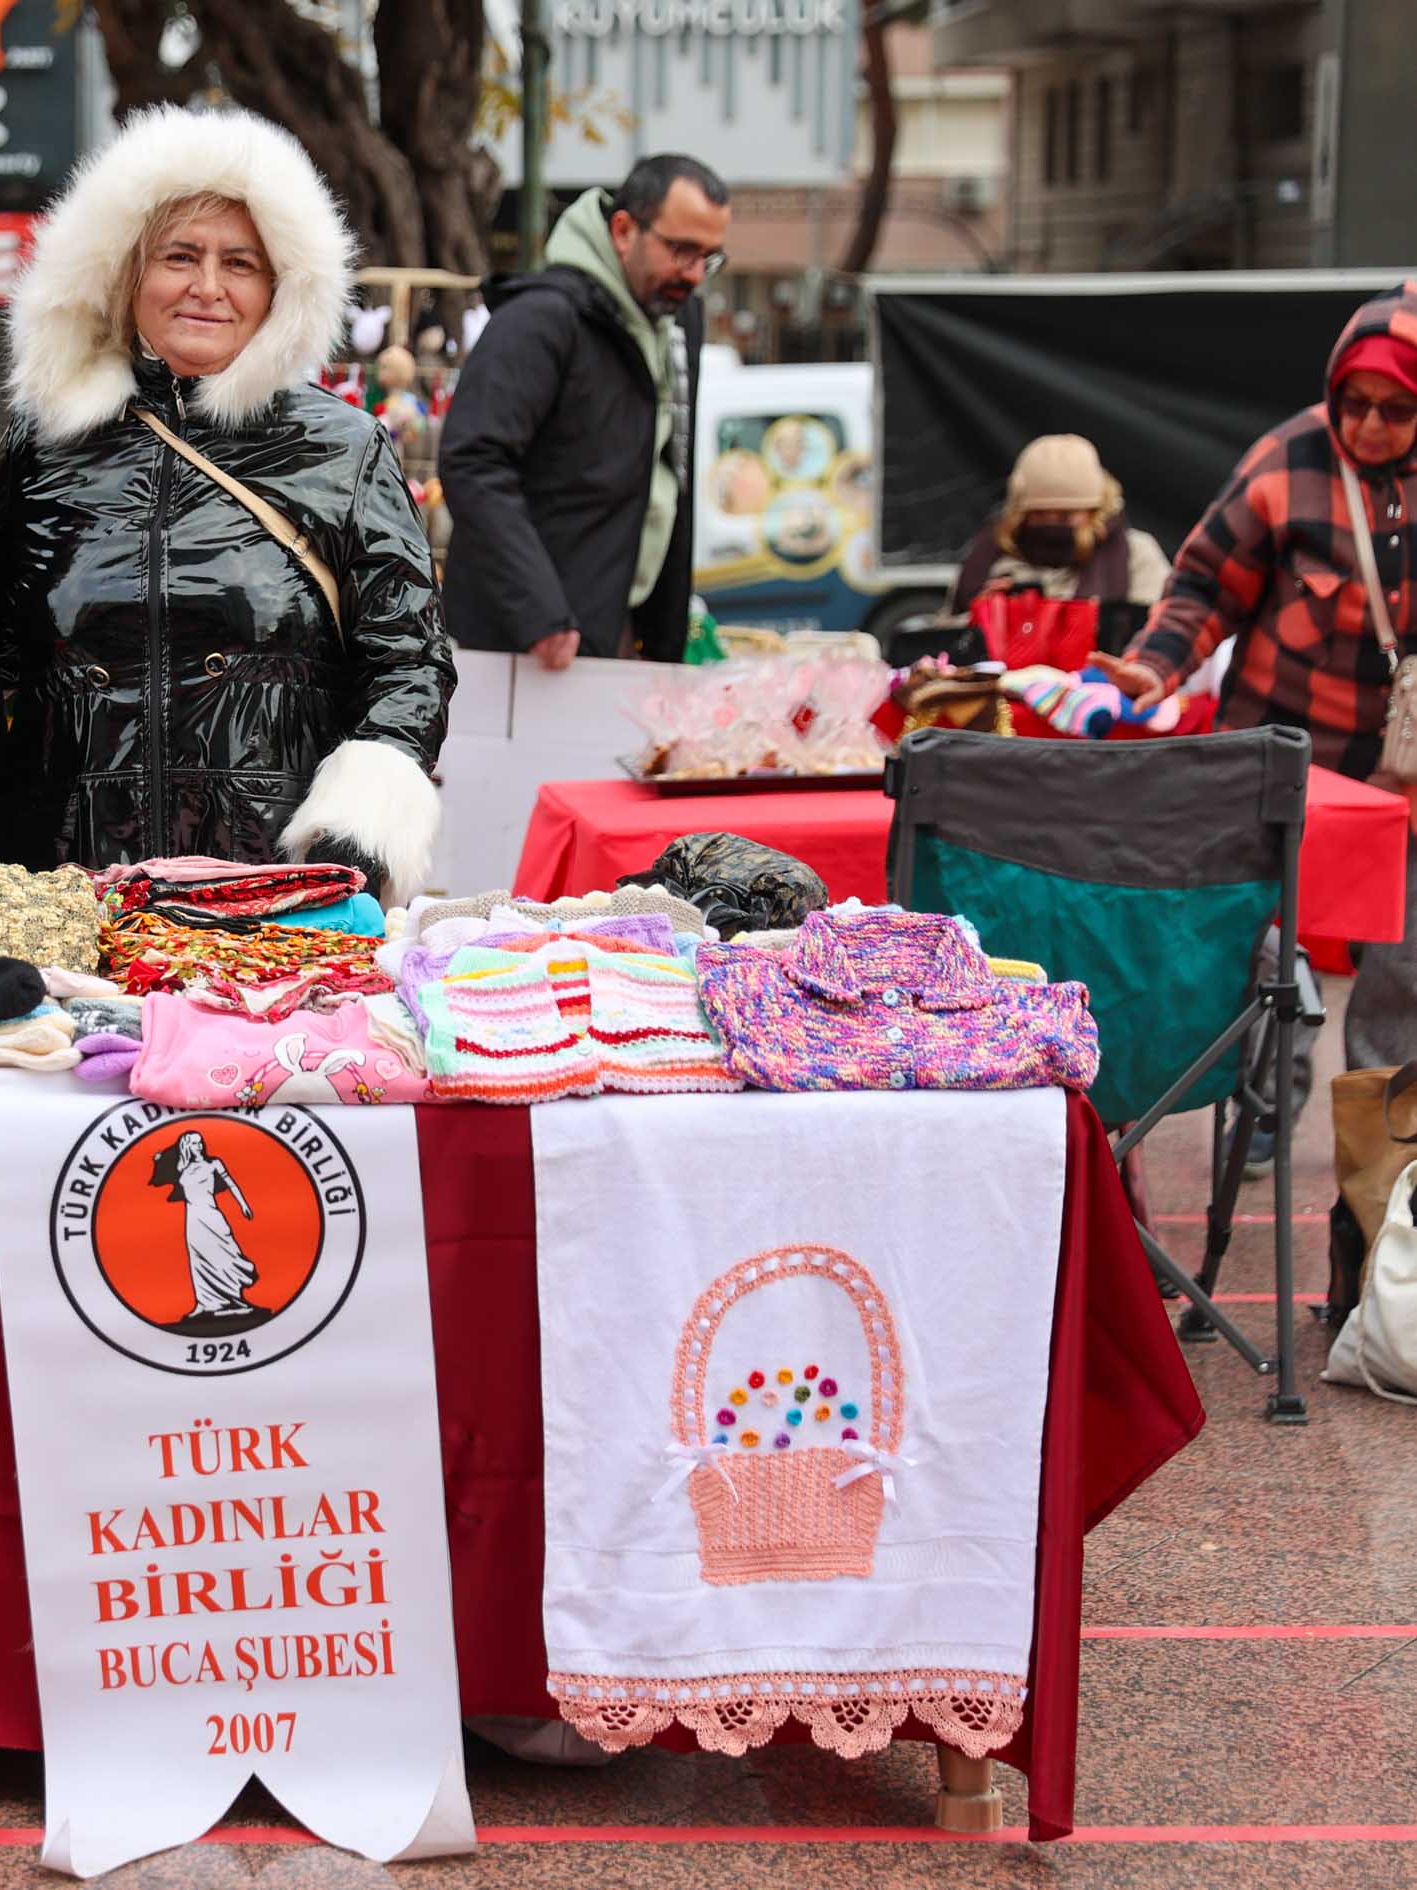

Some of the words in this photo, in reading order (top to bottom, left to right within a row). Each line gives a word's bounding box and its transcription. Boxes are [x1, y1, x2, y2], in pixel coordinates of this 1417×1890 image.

[61, 1155, 104, 1241] TÜRK
[275, 1112, 356, 1216] BİRLİĞİ
[186, 1339, 251, 1364] 1924
[149, 1417, 309, 1479] TÜRK
[86, 1489, 386, 1555] KADINLAR
[91, 1548, 391, 1623] BİRLİĞİ
[96, 1640, 226, 1690] BUCA
[234, 1619, 396, 1692] ŞUBESİ
[206, 1712, 297, 1755] 2007
